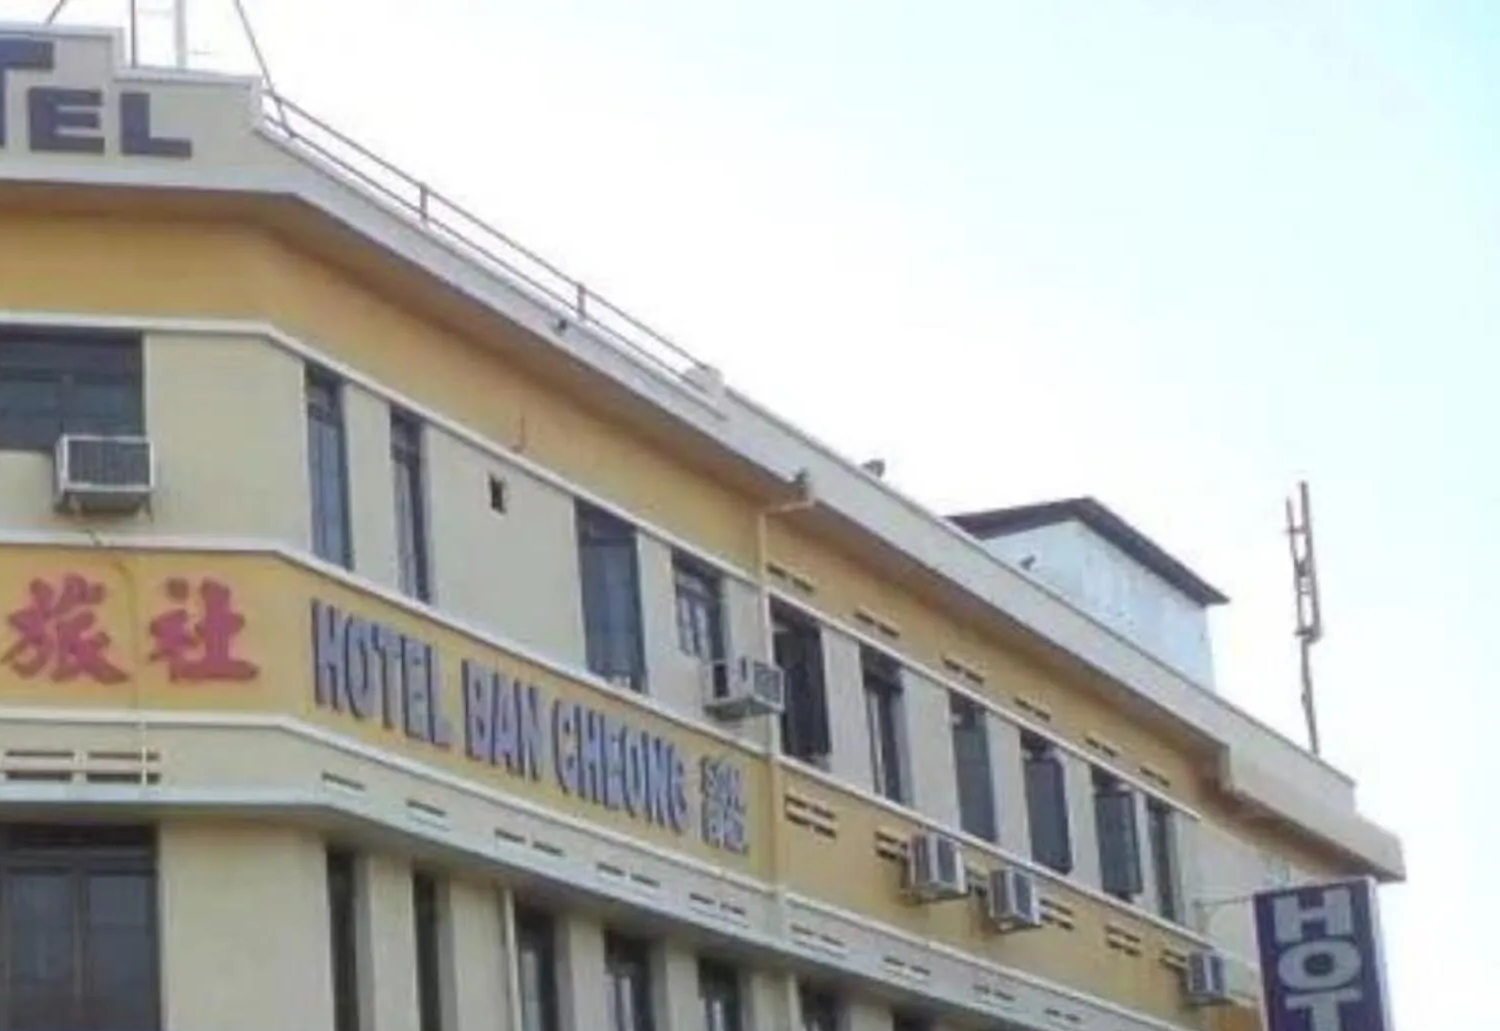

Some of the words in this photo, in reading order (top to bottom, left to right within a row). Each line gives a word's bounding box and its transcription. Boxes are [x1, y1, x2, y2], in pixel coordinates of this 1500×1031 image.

[311, 599, 450, 750] HOTEL
[461, 658, 541, 783] BAN
[551, 697, 688, 835] CHEONG
